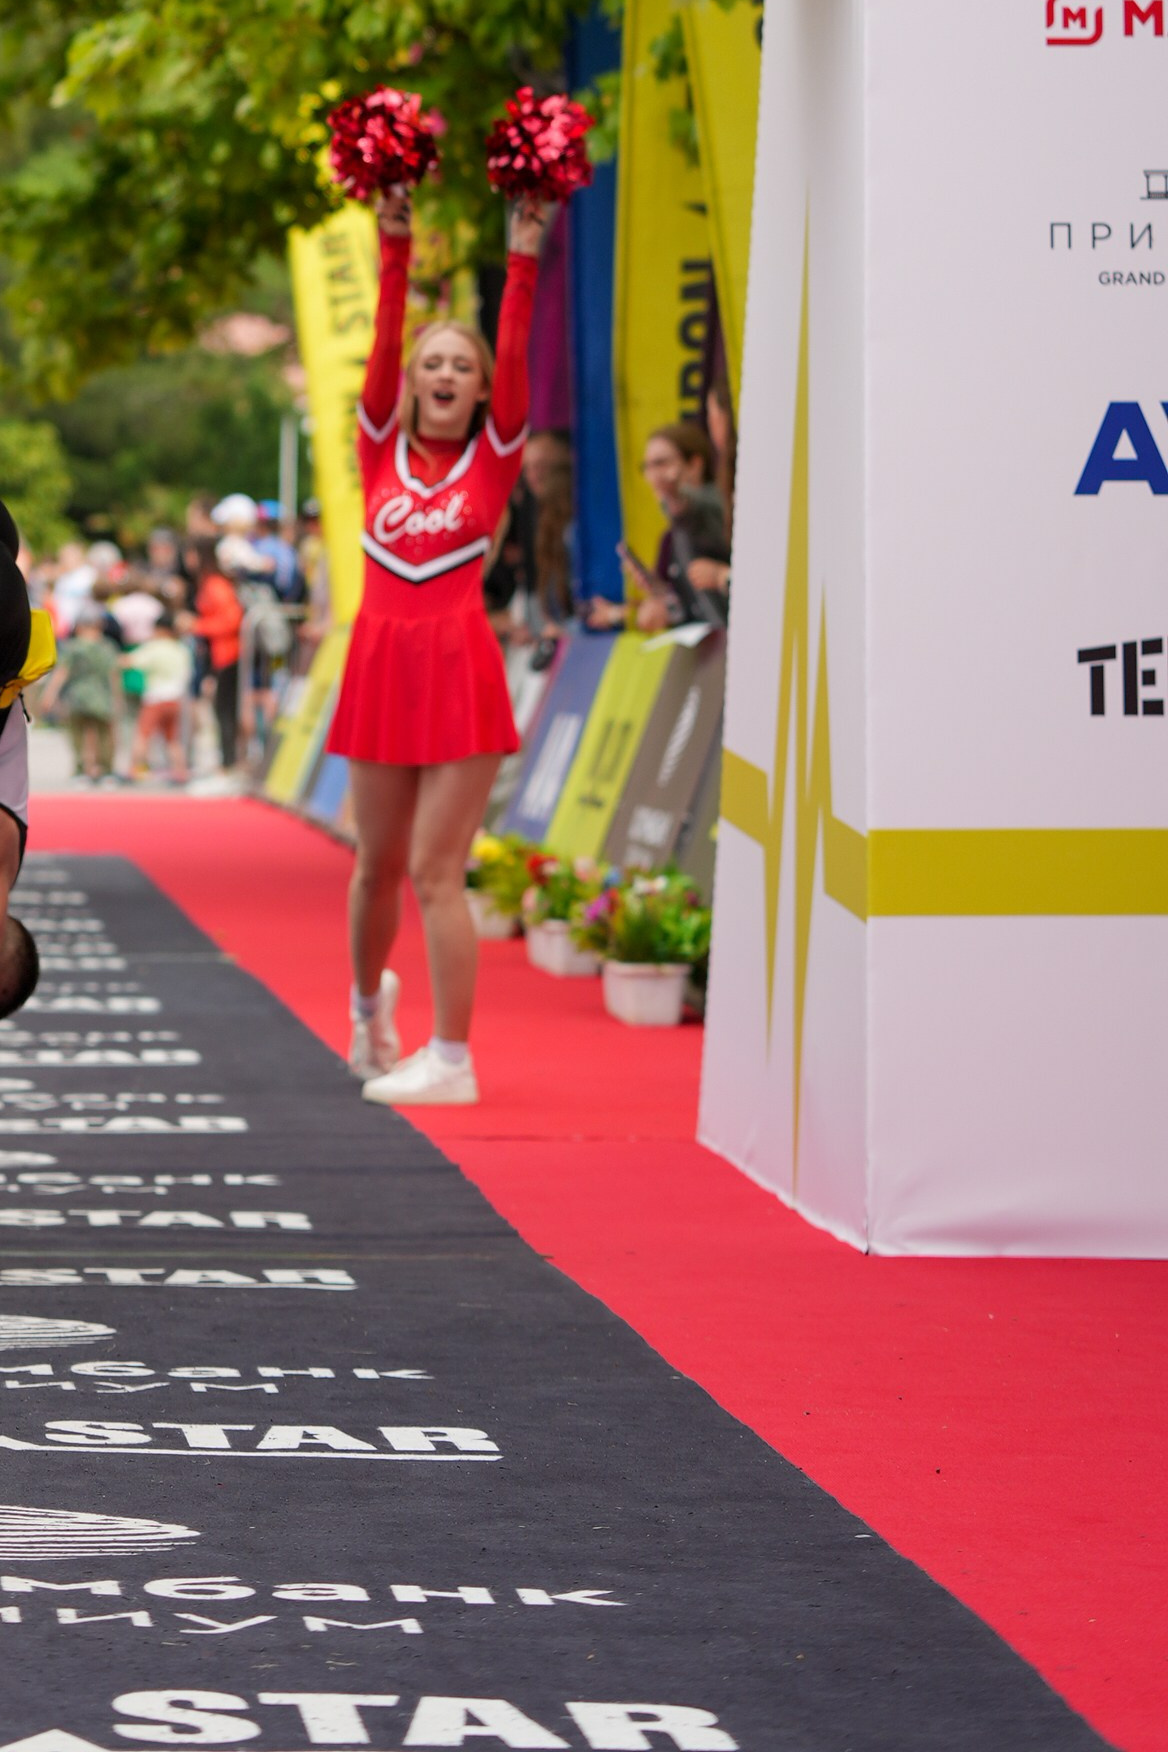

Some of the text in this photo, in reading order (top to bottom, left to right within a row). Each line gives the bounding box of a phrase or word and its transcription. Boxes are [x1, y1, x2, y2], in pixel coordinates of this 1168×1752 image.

[1050, 222, 1153, 249] ПРИ
[1098, 271, 1166, 285] GRAND
[1073, 401, 1168, 496] A
[373, 493, 465, 544] Cool
[0, 1268, 357, 1286] STAR
[44, 1420, 501, 1452] STAR
[111, 1689, 742, 1752] STAR
